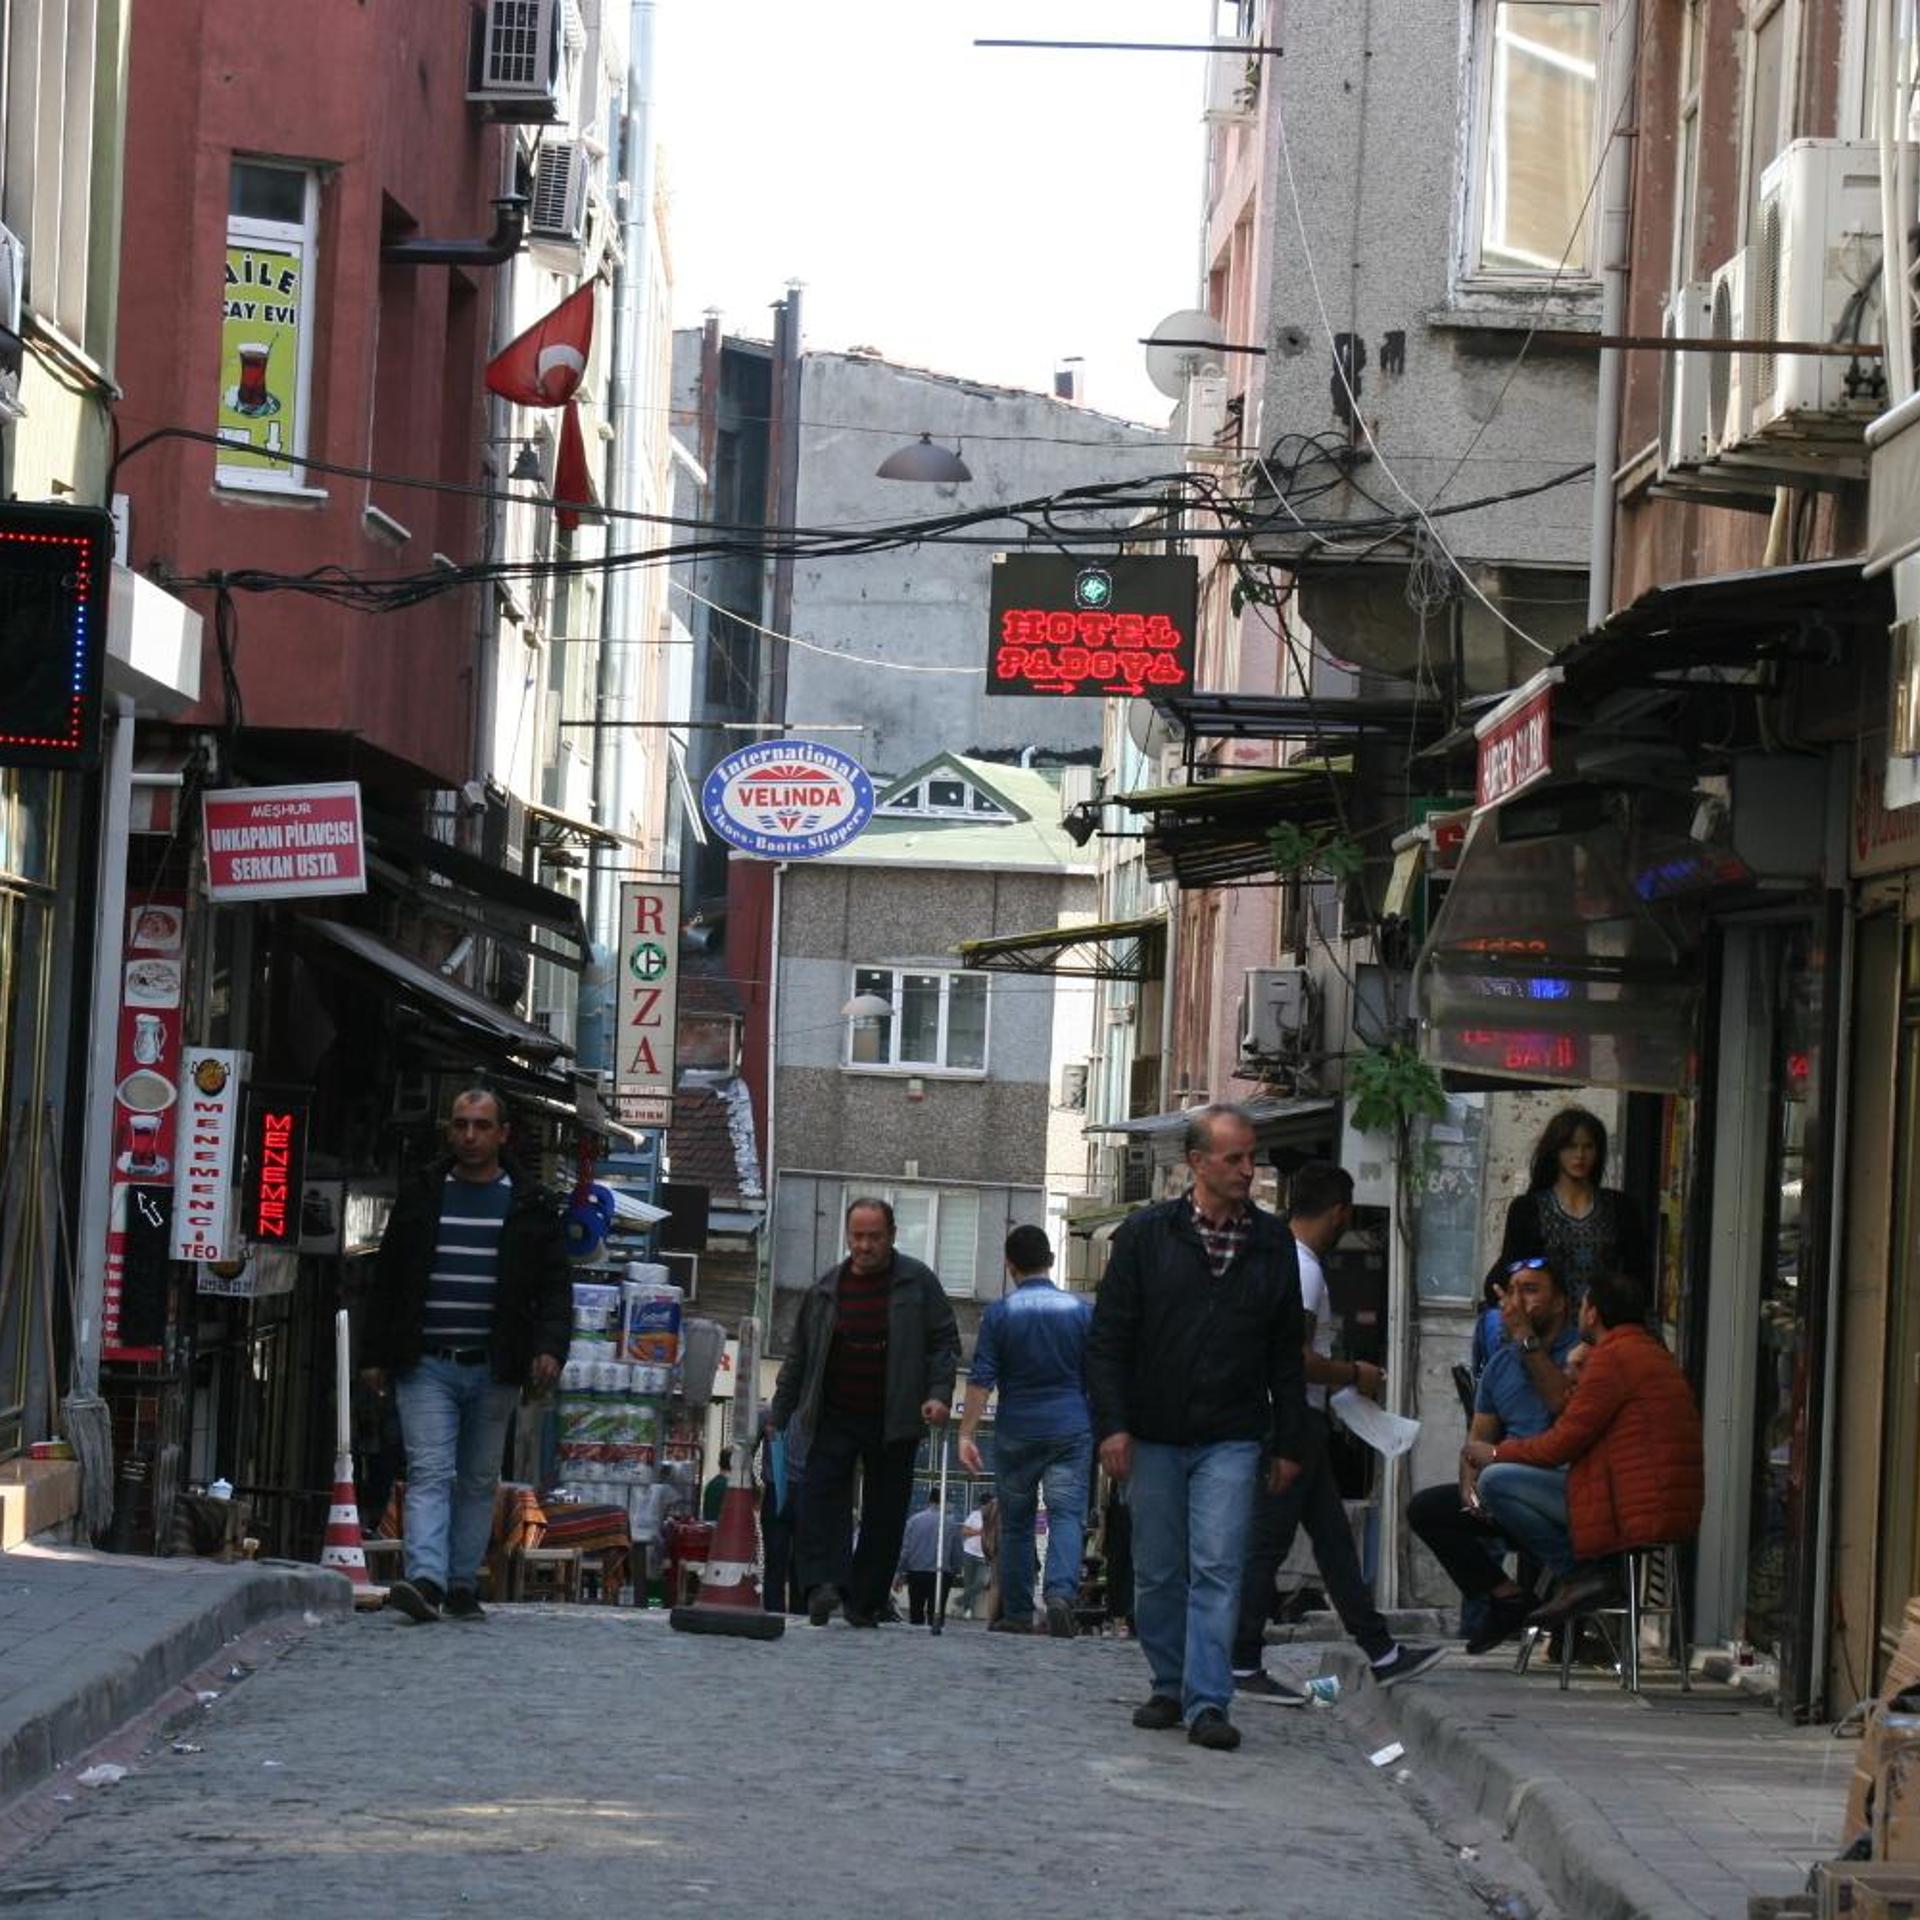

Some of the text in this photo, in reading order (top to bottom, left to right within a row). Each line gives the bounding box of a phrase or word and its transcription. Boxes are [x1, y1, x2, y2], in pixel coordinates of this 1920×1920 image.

[264, 304, 295, 324] EVİ
[1002, 609, 1182, 649] HOTEL
[717, 744, 861, 783] International
[211, 825, 282, 853] UNKAPANI
[231, 853, 338, 881] SERKAN USTA
[626, 896, 668, 1075] ROZA
[258, 1112, 292, 1237] MENEMEN
[180, 1243, 218, 1260] TEO
